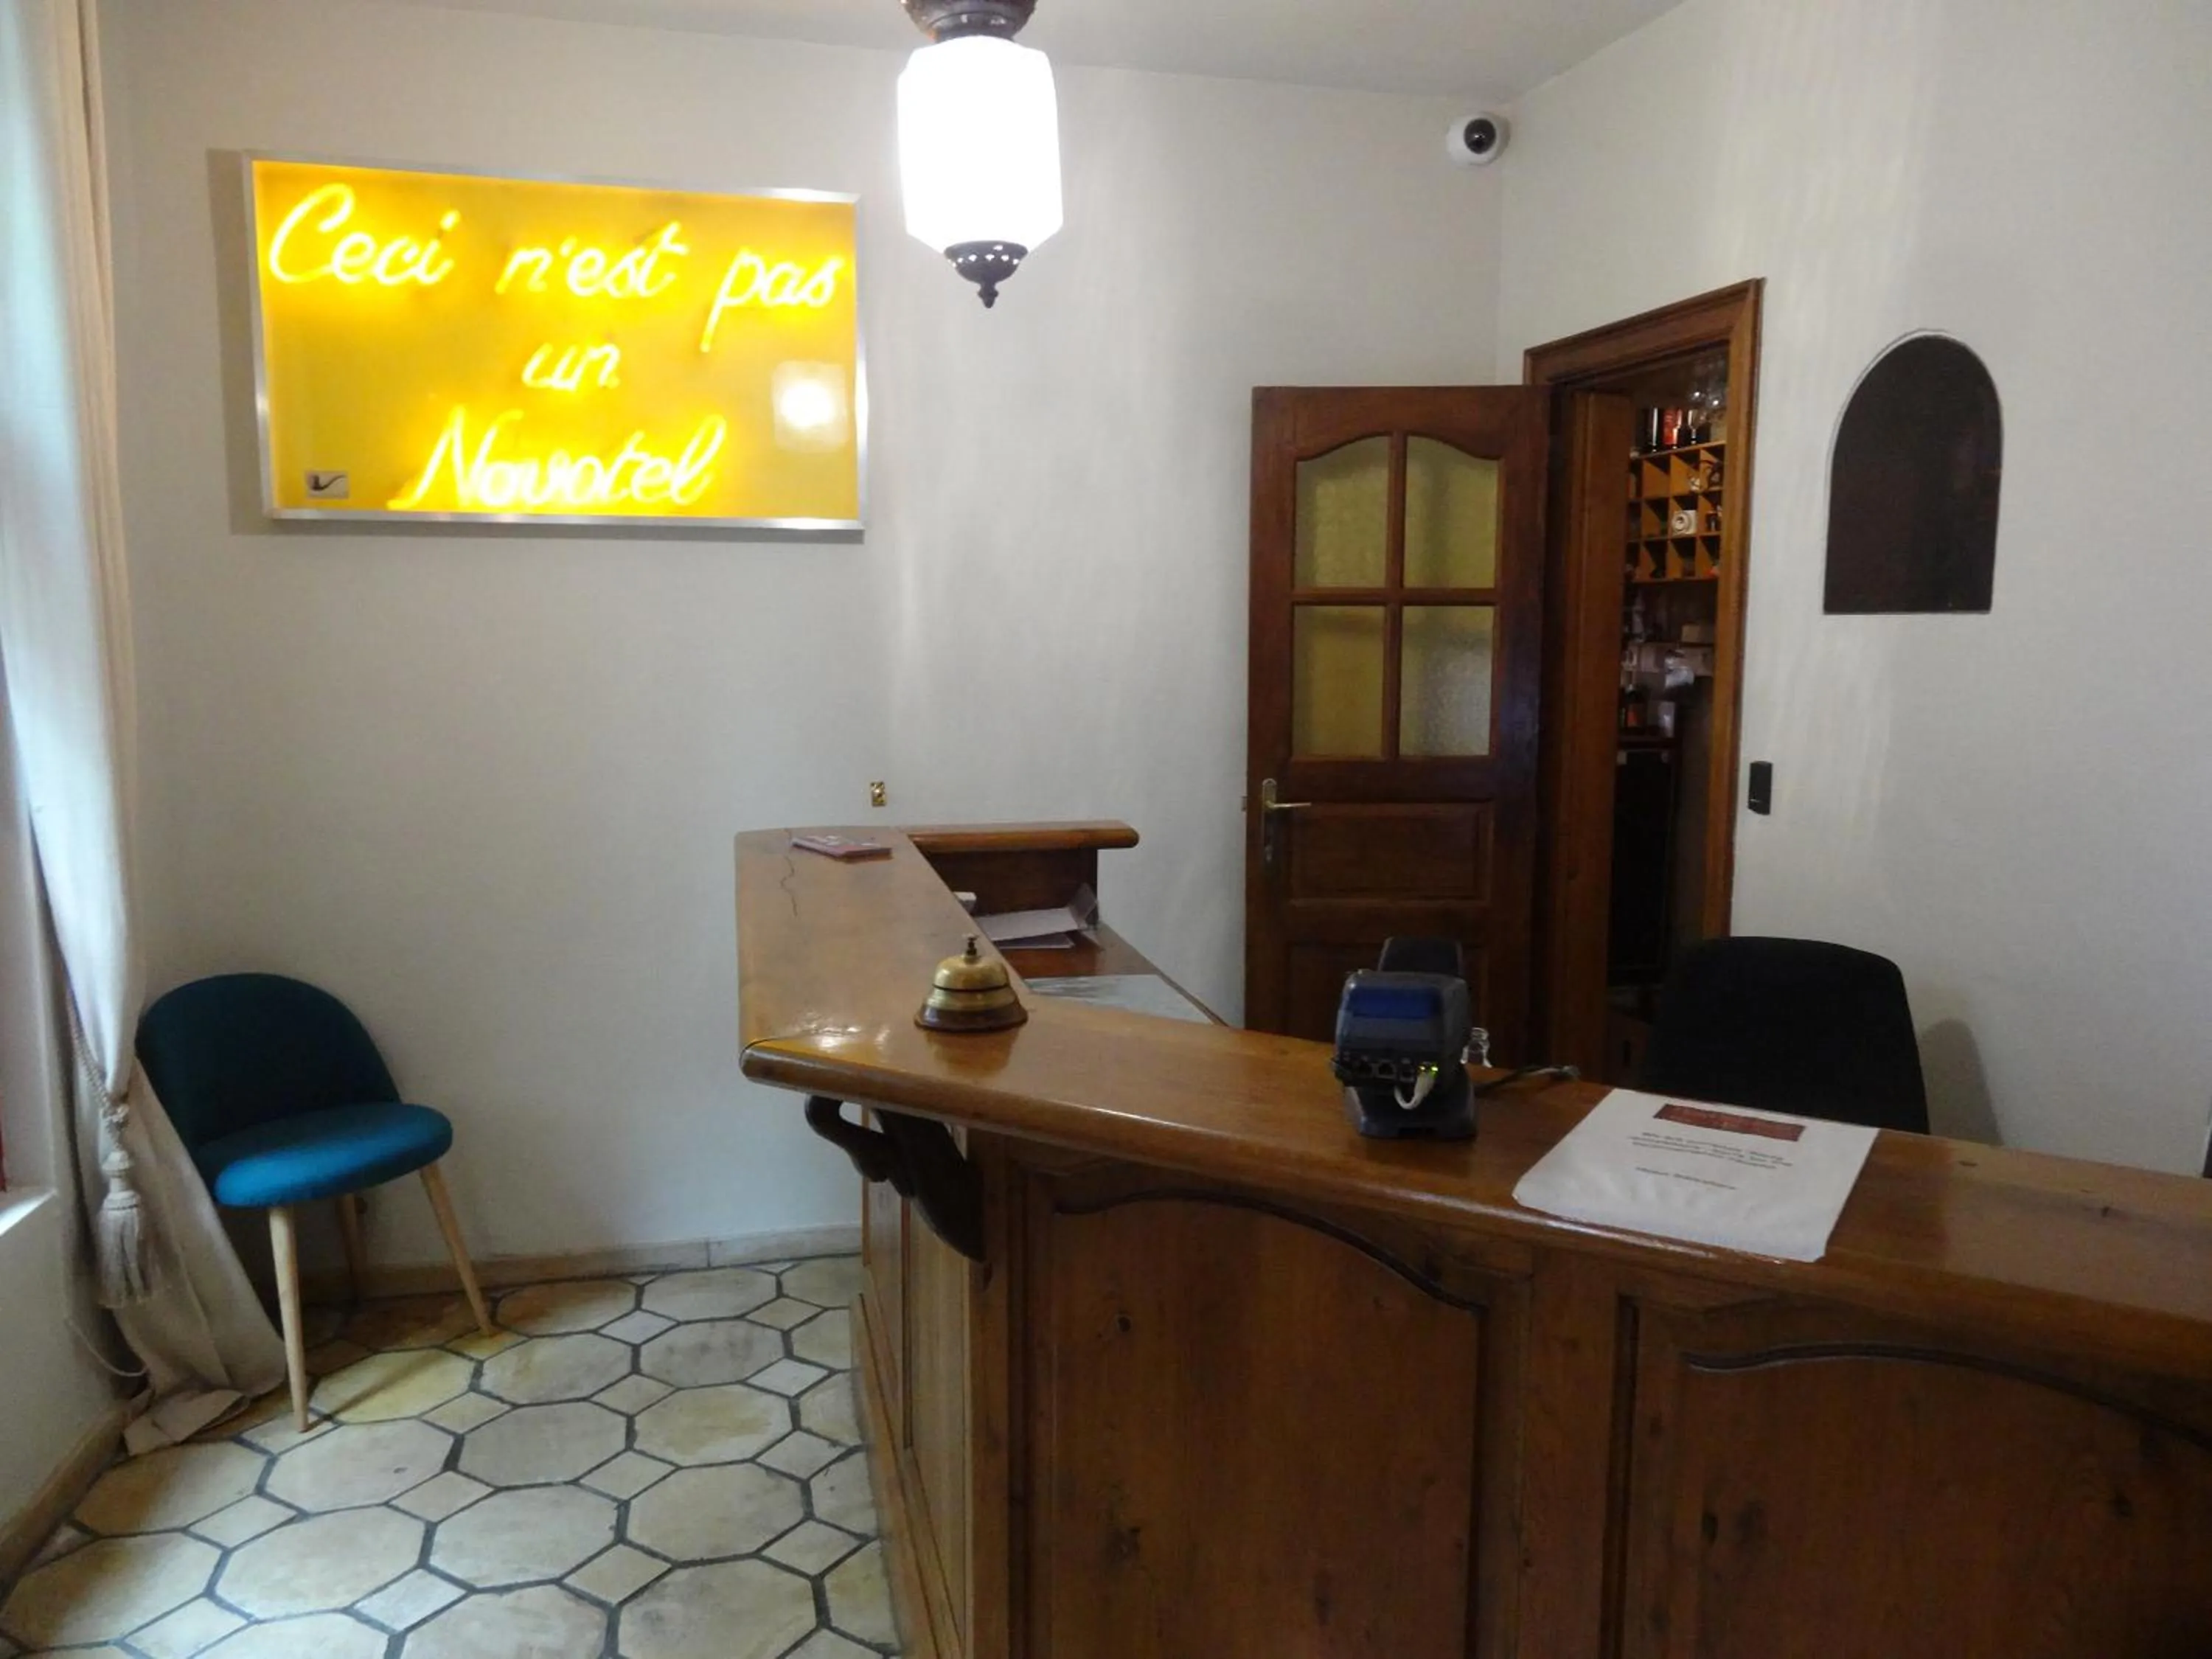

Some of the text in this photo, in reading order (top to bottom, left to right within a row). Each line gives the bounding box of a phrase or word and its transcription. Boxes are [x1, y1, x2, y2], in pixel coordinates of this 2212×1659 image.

[269, 184, 844, 352] Ceci n'est pas
[522, 341, 619, 391] un
[388, 405, 726, 509] Novotel
